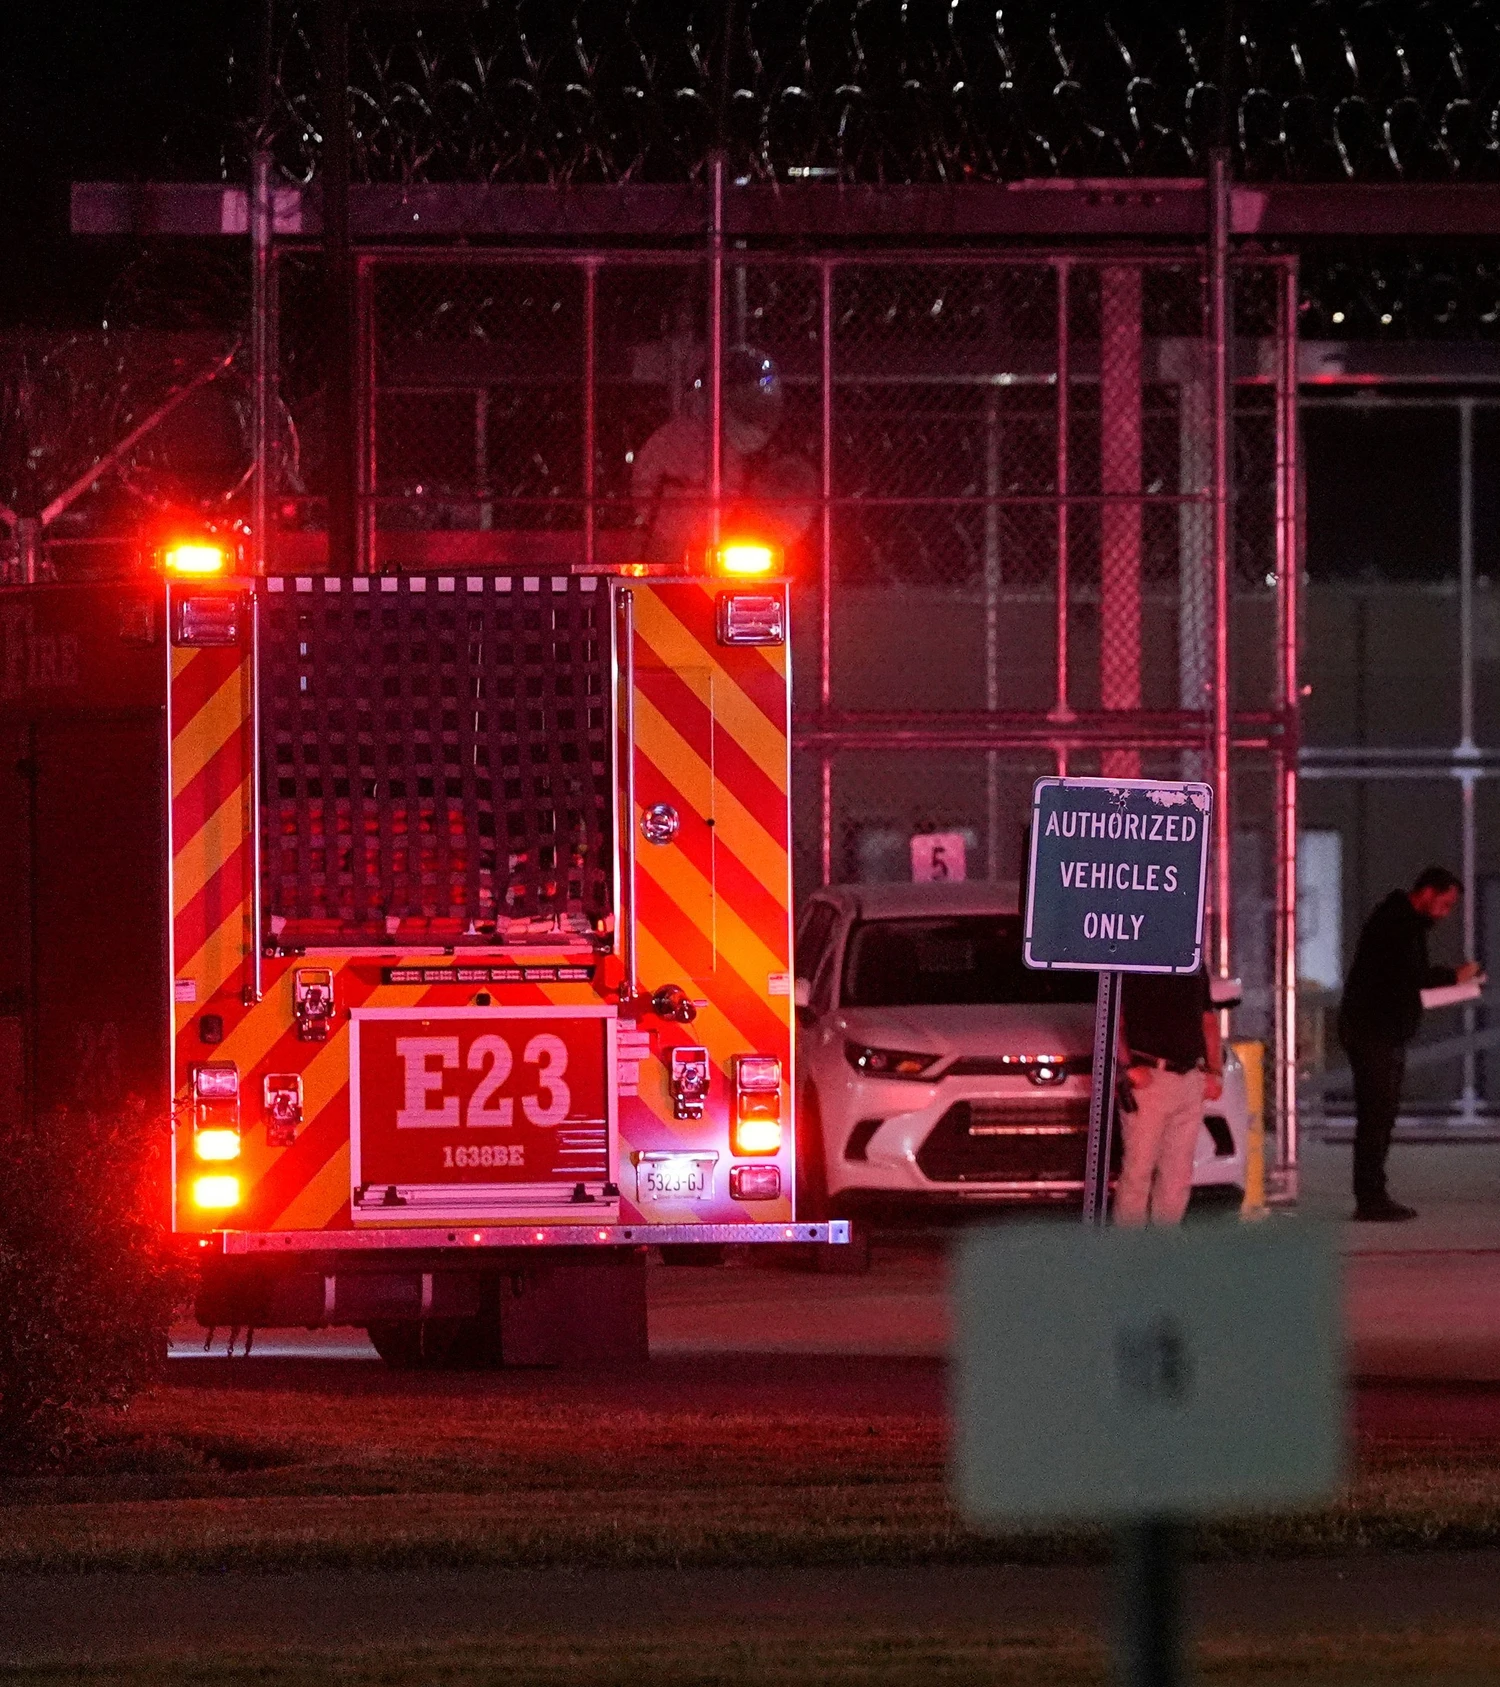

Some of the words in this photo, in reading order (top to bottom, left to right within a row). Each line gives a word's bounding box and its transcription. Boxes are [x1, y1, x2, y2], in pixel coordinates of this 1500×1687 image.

[1045, 811, 1197, 842] AUTHORIZED
[931, 846, 948, 880] 5
[1060, 861, 1178, 892] VEHICLES
[1083, 912, 1145, 940] ONLY
[396, 1033, 571, 1129] E23
[442, 1145, 525, 1168] 1638BE
[647, 1172, 705, 1192] 5323-GJ
